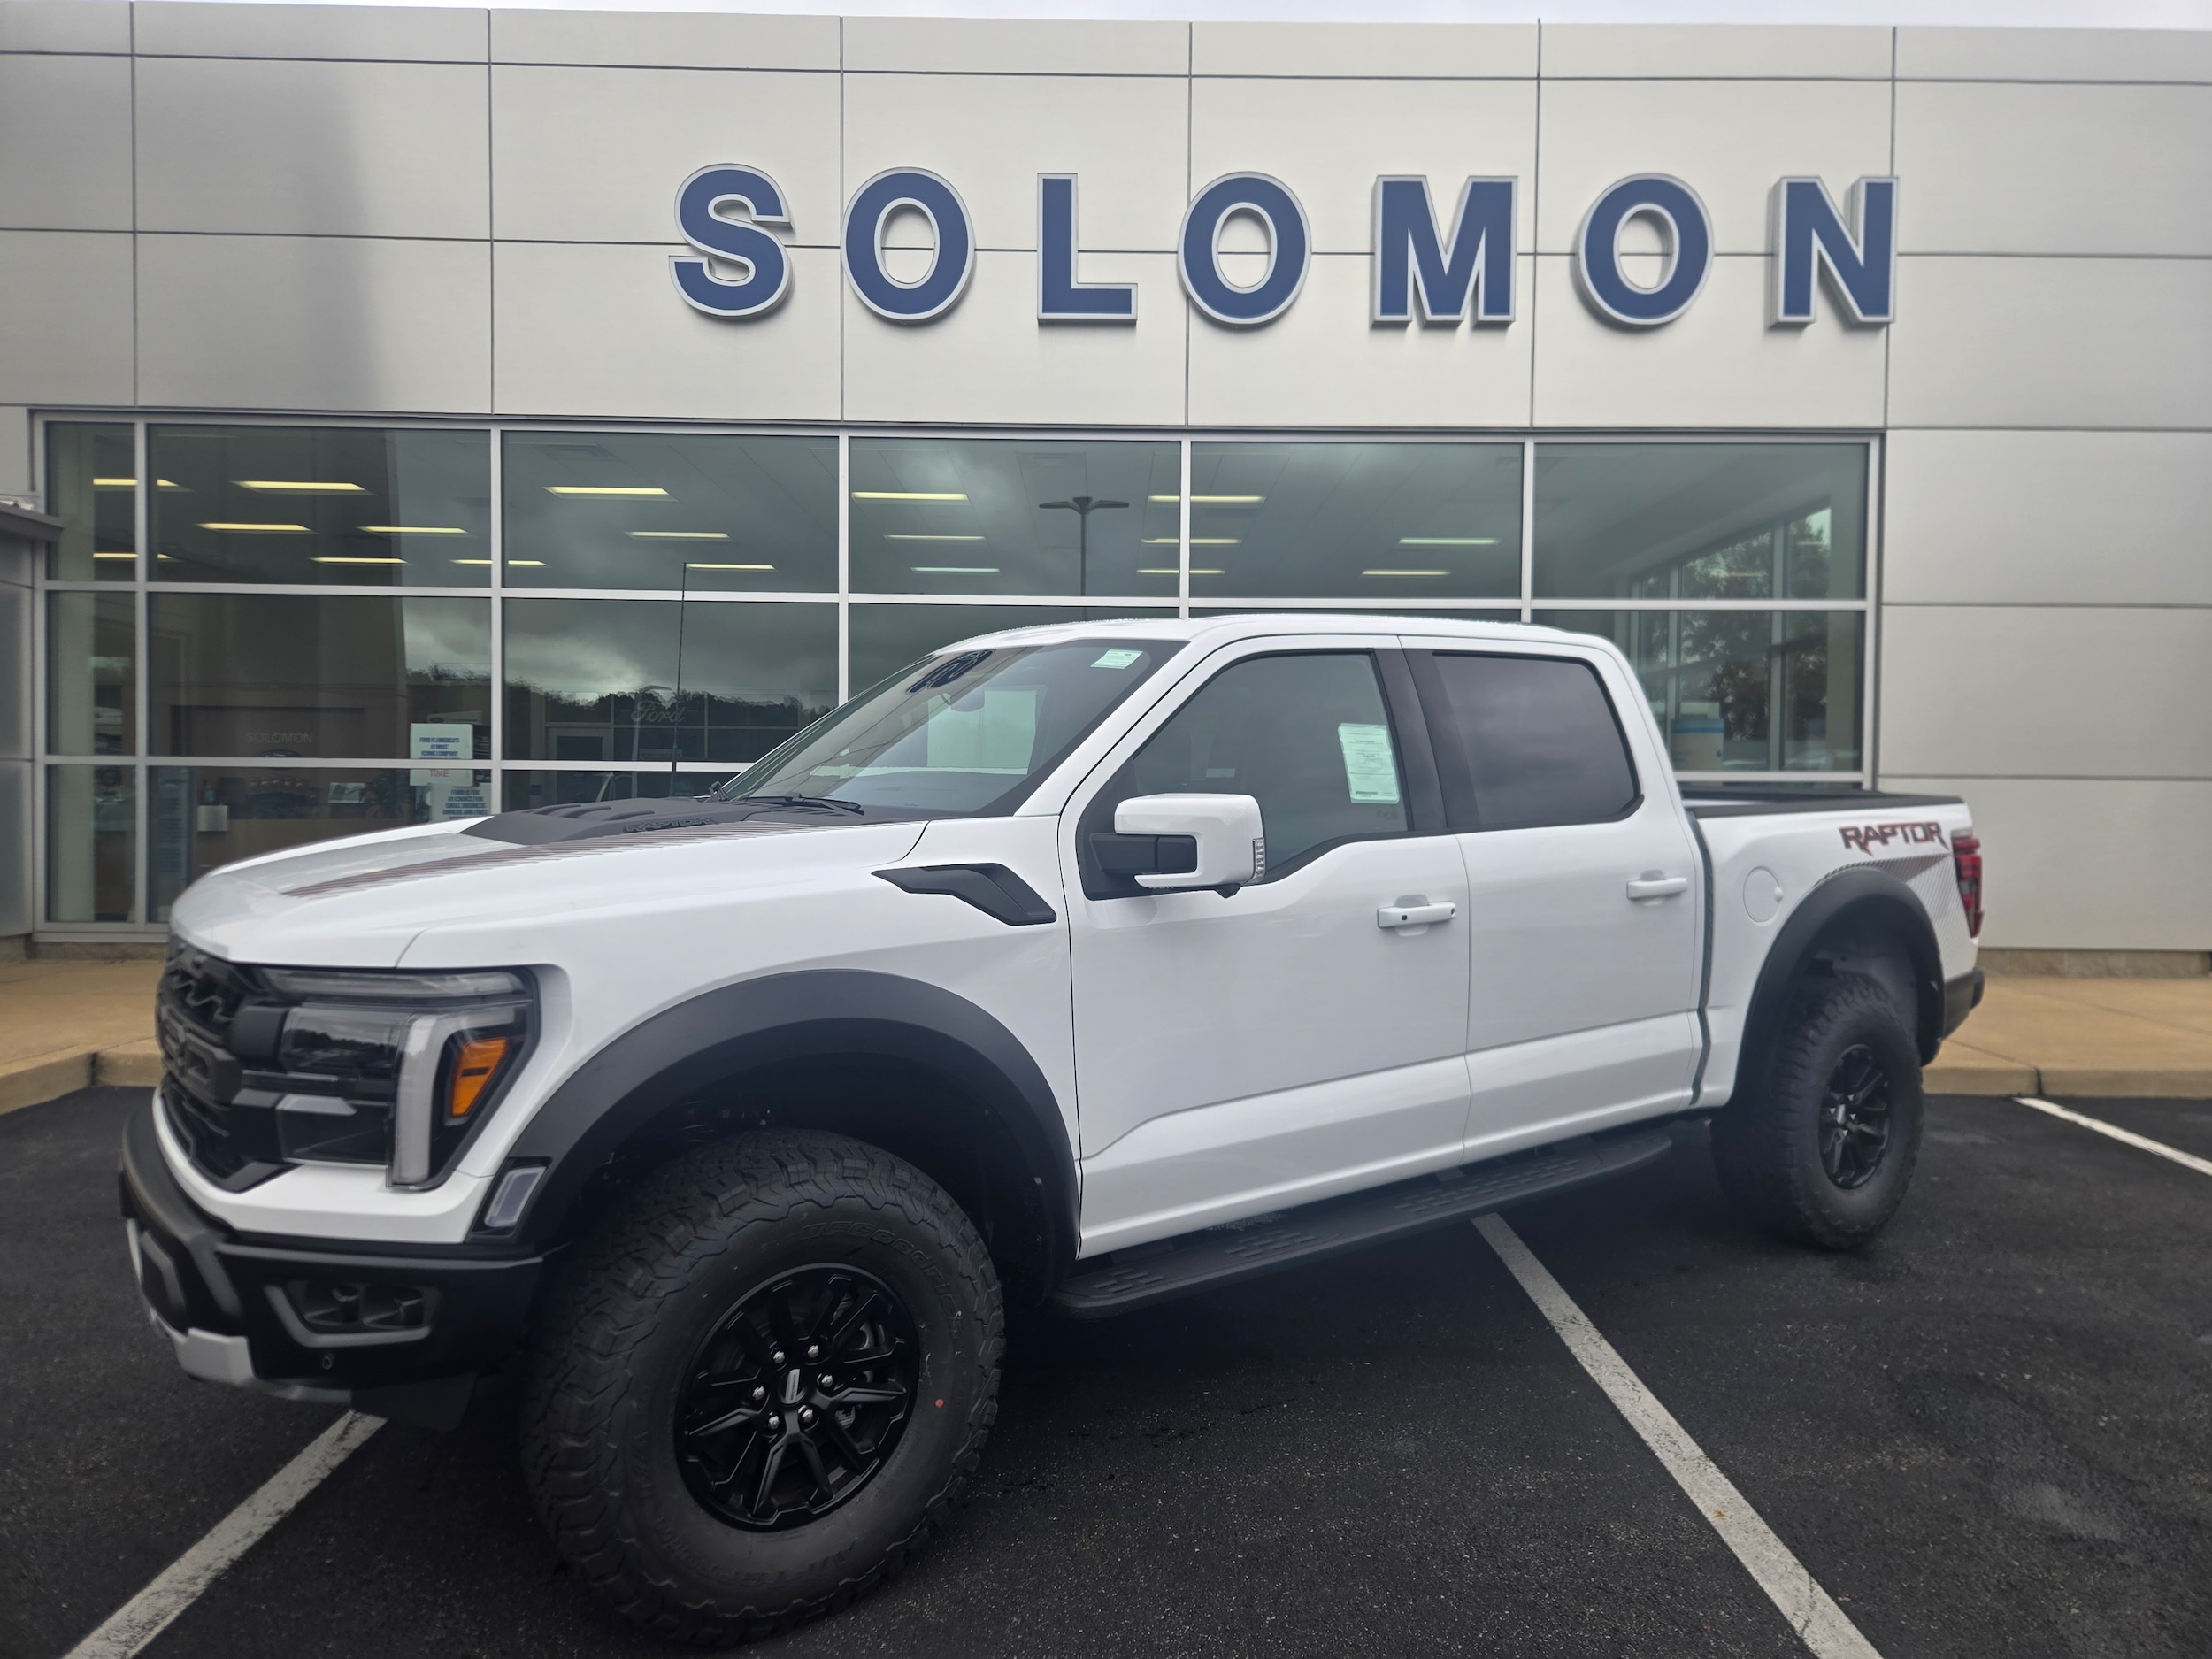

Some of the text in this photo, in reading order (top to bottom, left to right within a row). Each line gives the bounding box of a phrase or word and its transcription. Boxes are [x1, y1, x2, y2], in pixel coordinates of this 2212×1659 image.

[669, 163, 1899, 326] SOLOMON
[631, 700, 687, 723] Ford
[247, 732, 313, 743] SOLOMON
[623, 817, 719, 833] RAPTOR
[1839, 822, 1949, 857] RAPTOR
